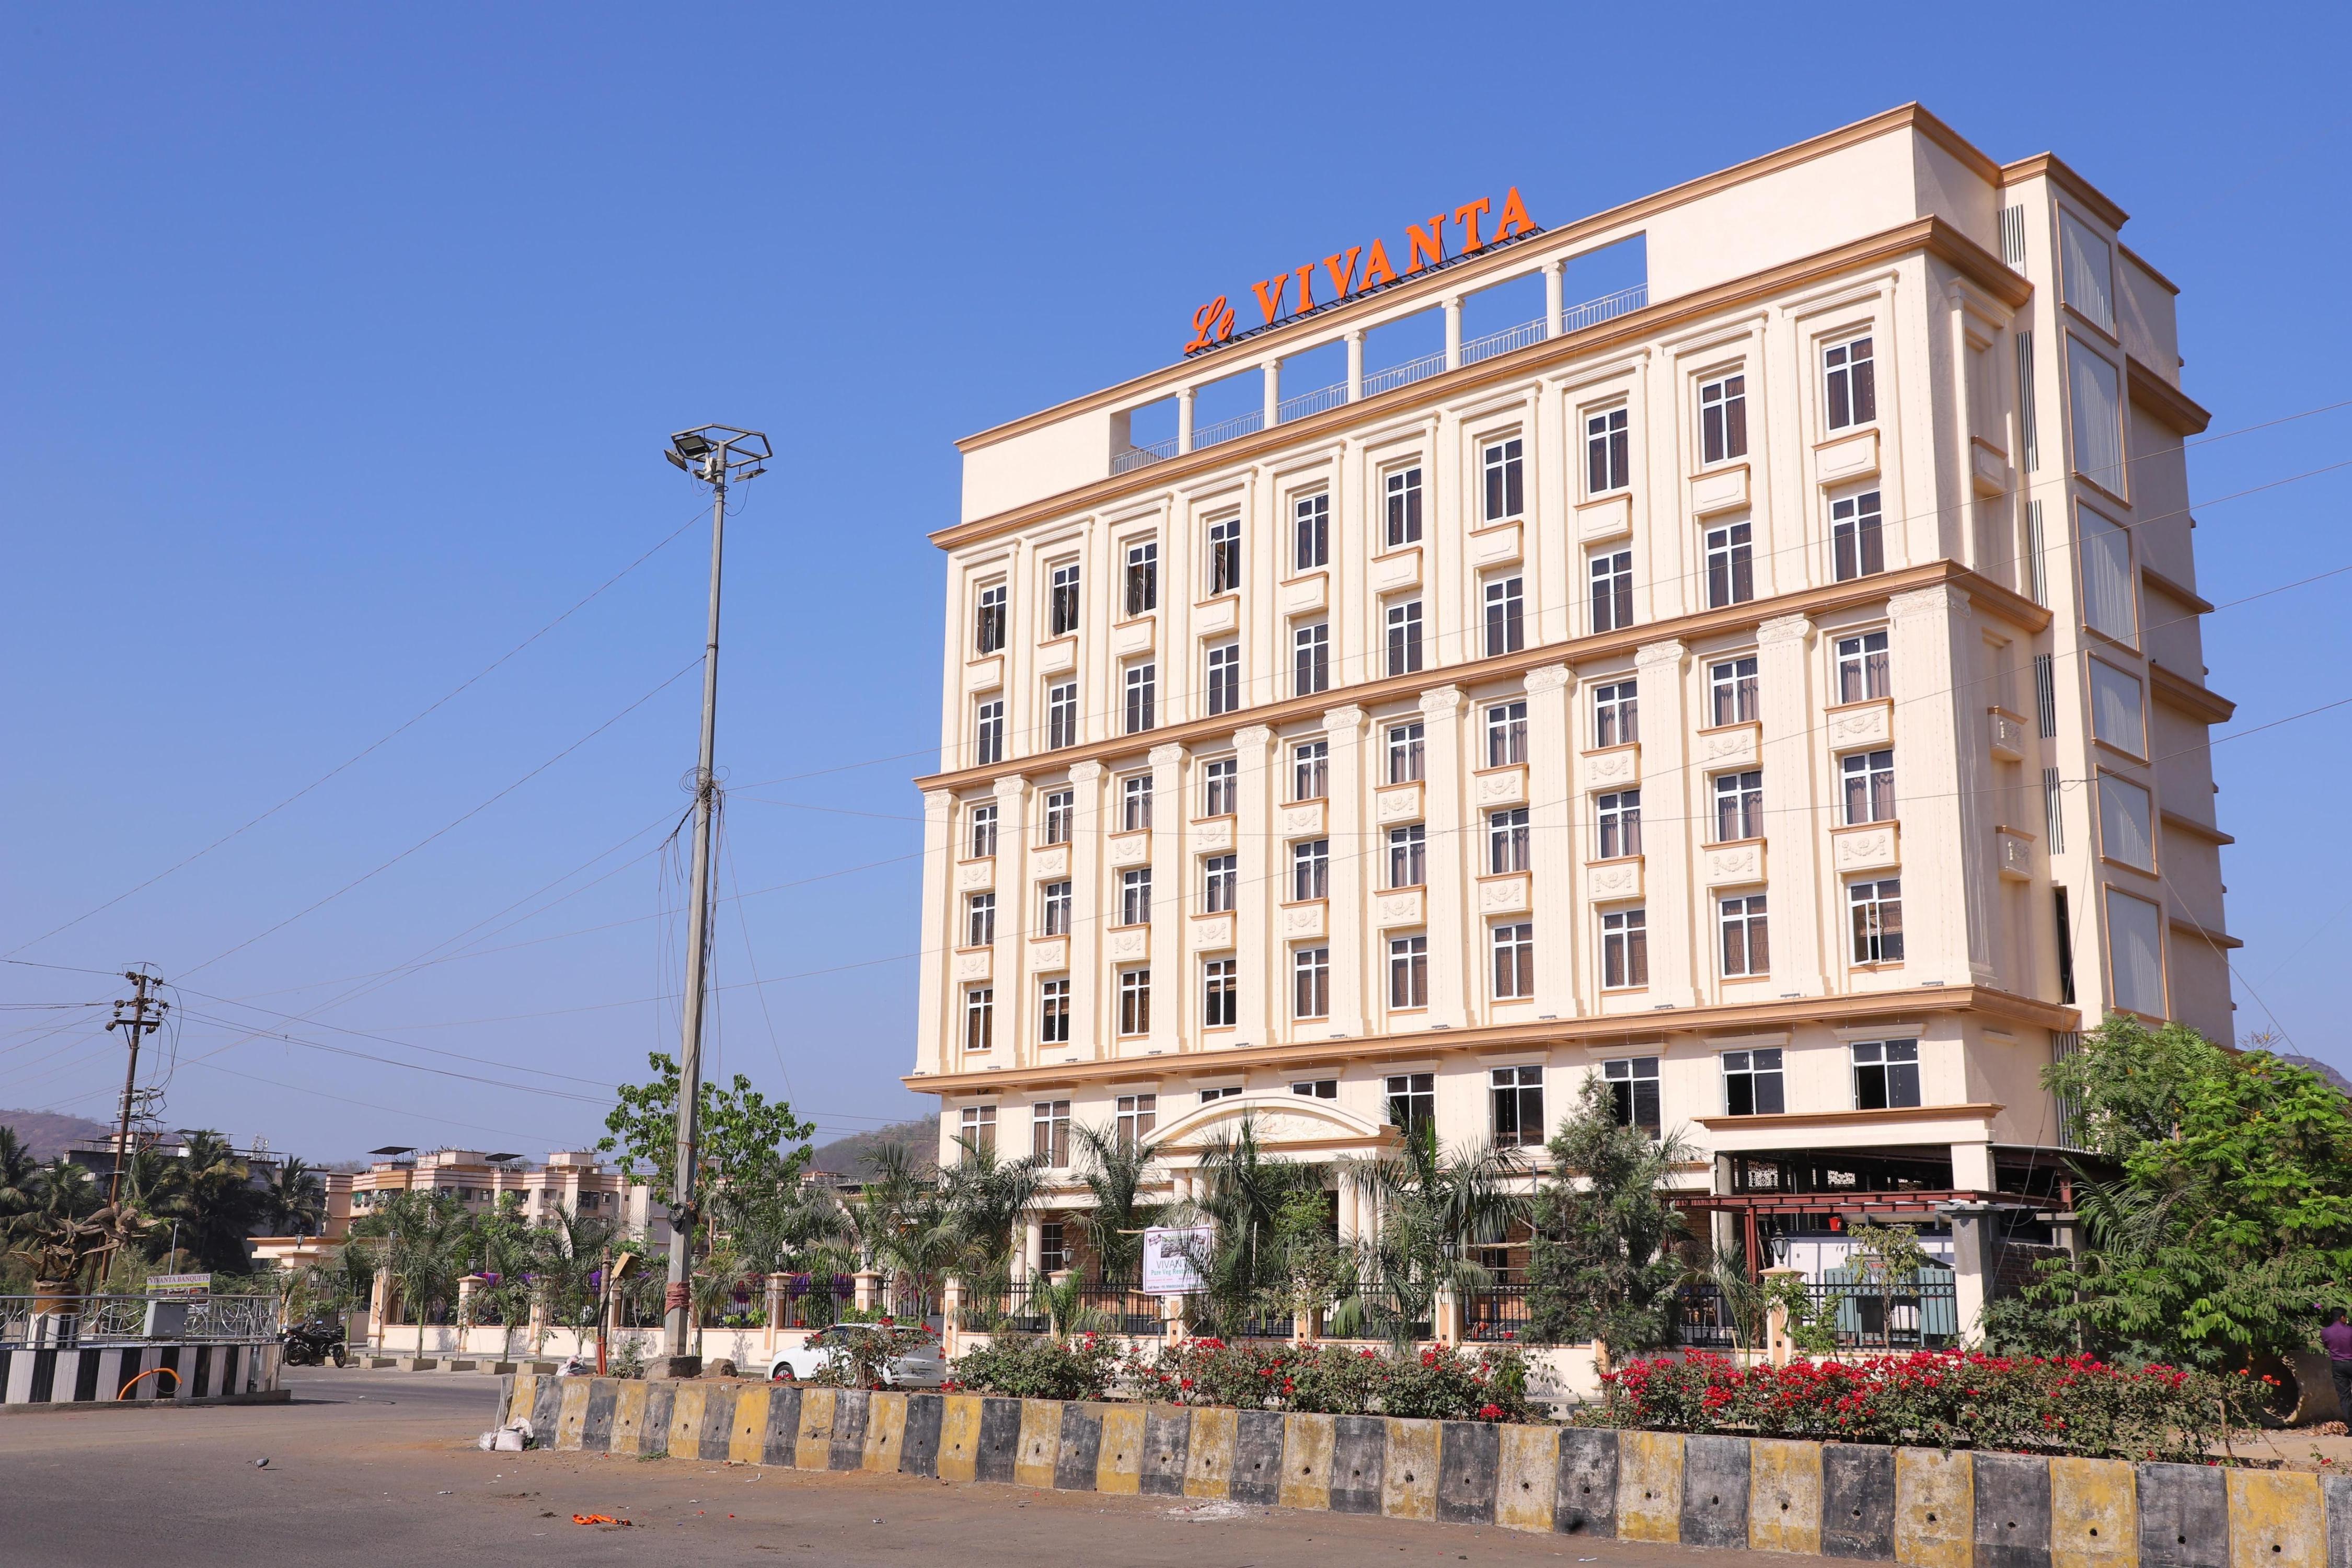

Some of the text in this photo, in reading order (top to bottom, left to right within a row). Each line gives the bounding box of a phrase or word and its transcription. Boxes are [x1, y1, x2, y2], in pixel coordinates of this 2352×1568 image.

[1184, 187, 1537, 353] Le VIVANTA
[1156, 1259, 1192, 1269] VIVANT
